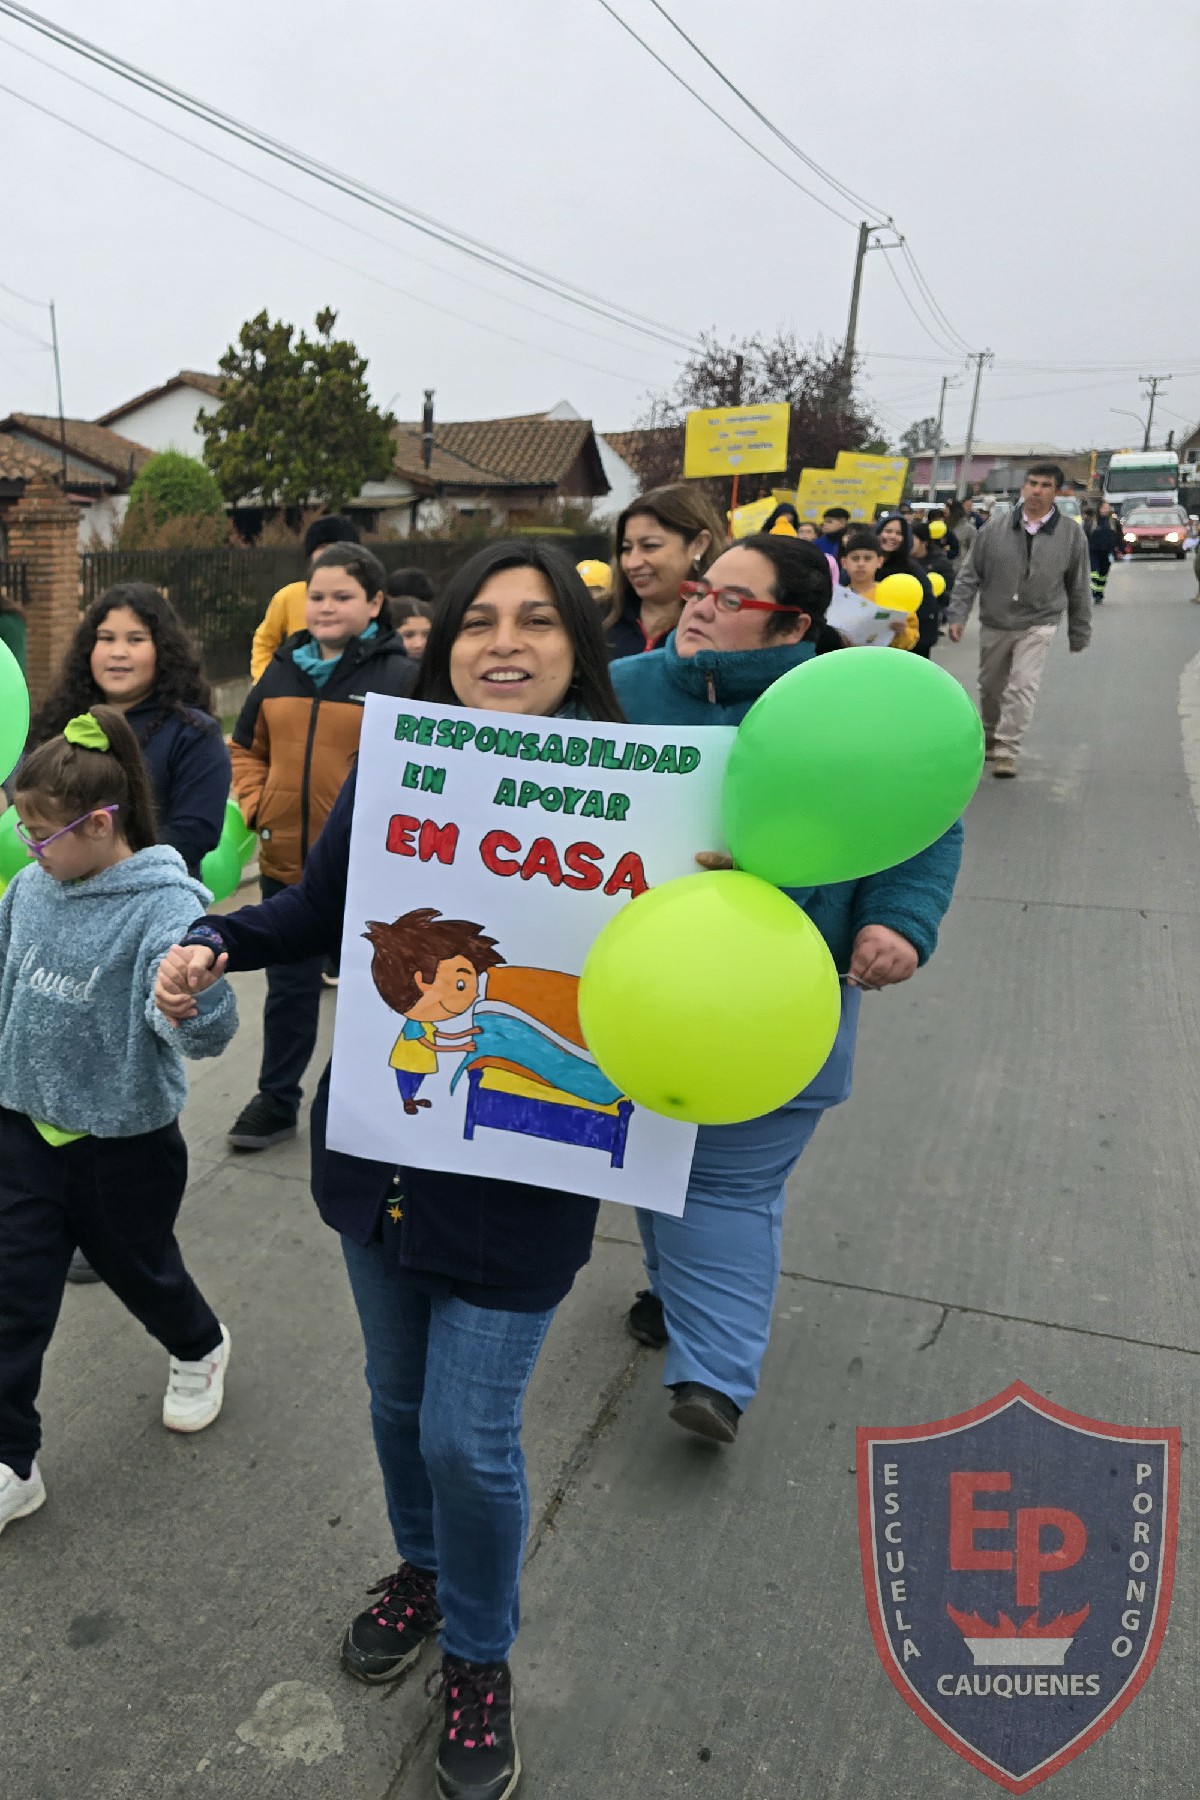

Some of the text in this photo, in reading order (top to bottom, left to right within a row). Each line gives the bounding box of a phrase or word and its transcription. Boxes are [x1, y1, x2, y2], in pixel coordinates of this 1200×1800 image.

[394, 713, 701, 774] RESPONSABILIDAD
[401, 761, 630, 821] EN APOYAR
[386, 814, 650, 900] EN CASA
